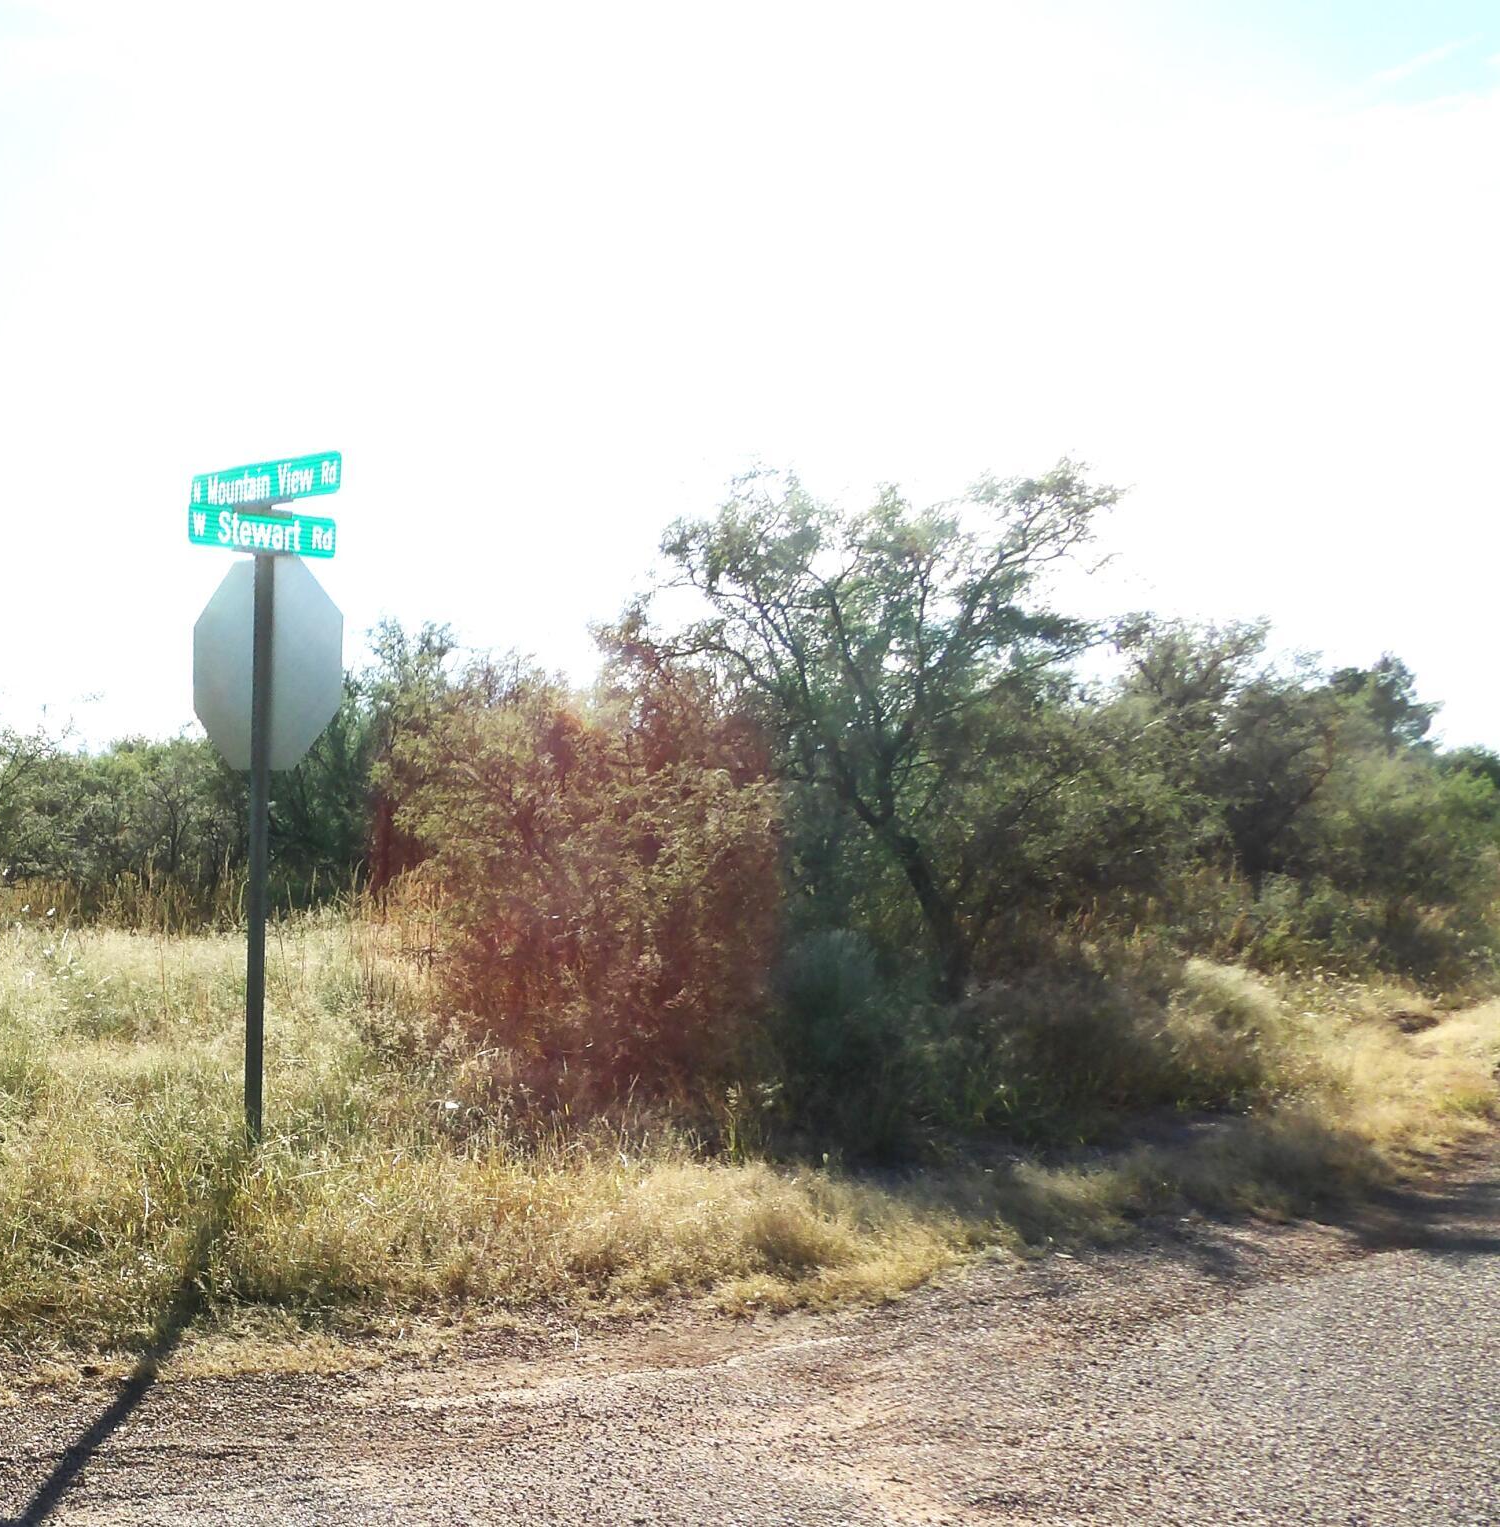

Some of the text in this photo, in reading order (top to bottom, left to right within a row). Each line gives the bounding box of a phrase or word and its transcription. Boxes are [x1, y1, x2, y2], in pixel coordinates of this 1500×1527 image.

[193, 460, 337, 505] N Mountain View Rd
[193, 511, 333, 552] W Stewart Rd
